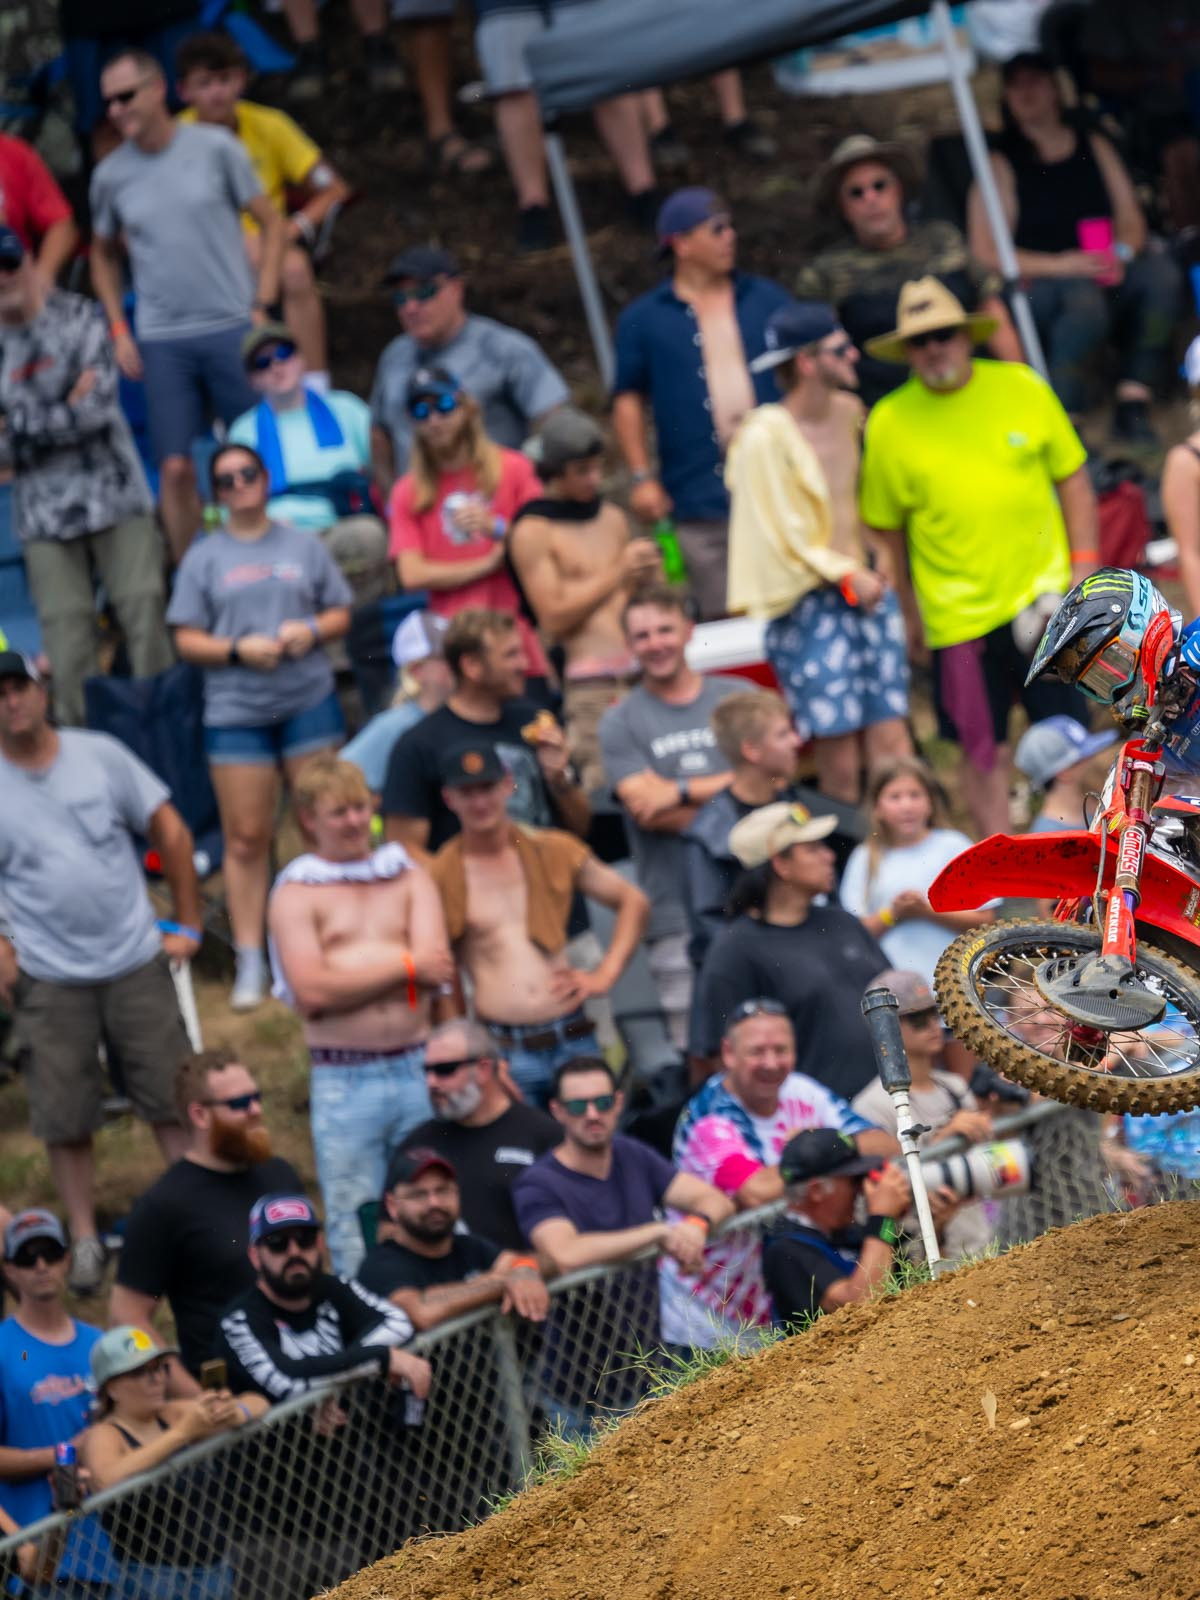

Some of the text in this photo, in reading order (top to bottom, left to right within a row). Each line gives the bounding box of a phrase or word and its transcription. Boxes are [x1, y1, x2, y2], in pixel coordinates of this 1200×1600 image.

[1121, 830, 1143, 876] SHOWA
[1107, 896, 1120, 944] DUNLOP
[961, 938, 986, 976] DUNLOP
